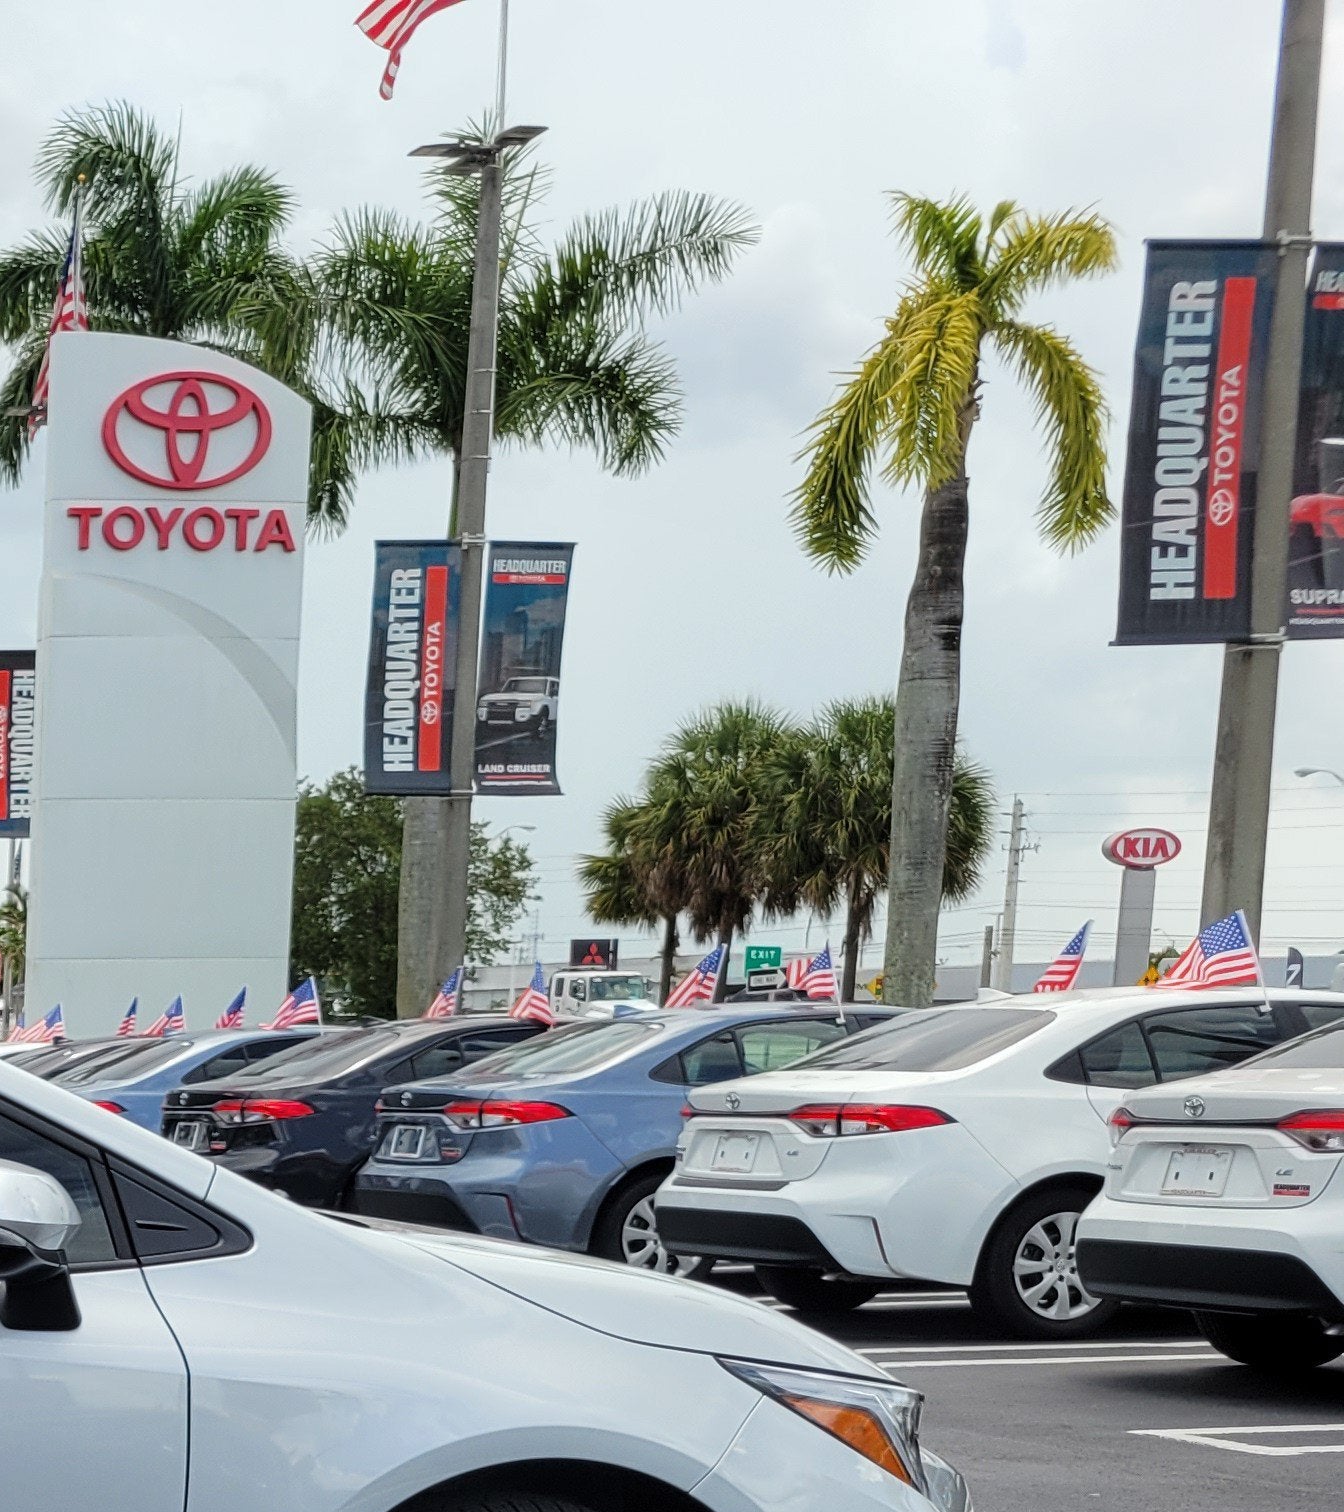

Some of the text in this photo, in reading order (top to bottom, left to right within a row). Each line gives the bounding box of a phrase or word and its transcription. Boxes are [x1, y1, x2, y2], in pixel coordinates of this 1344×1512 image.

[1150, 279, 1217, 600] HEADQUARTER
[1213, 364, 1242, 486] TOYOTA
[67, 506, 296, 552] TOYOTA
[493, 559, 566, 573] HEADQUARTER
[383, 568, 422, 772] HEADQUARTER
[424, 621, 441, 699] TOYOTA
[8, 669, 35, 819] HEADQUARTER
[478, 764, 551, 773] LAND CRUISER
[1123, 837, 1170, 858] KIA
[750, 950, 776, 960] EXIT
